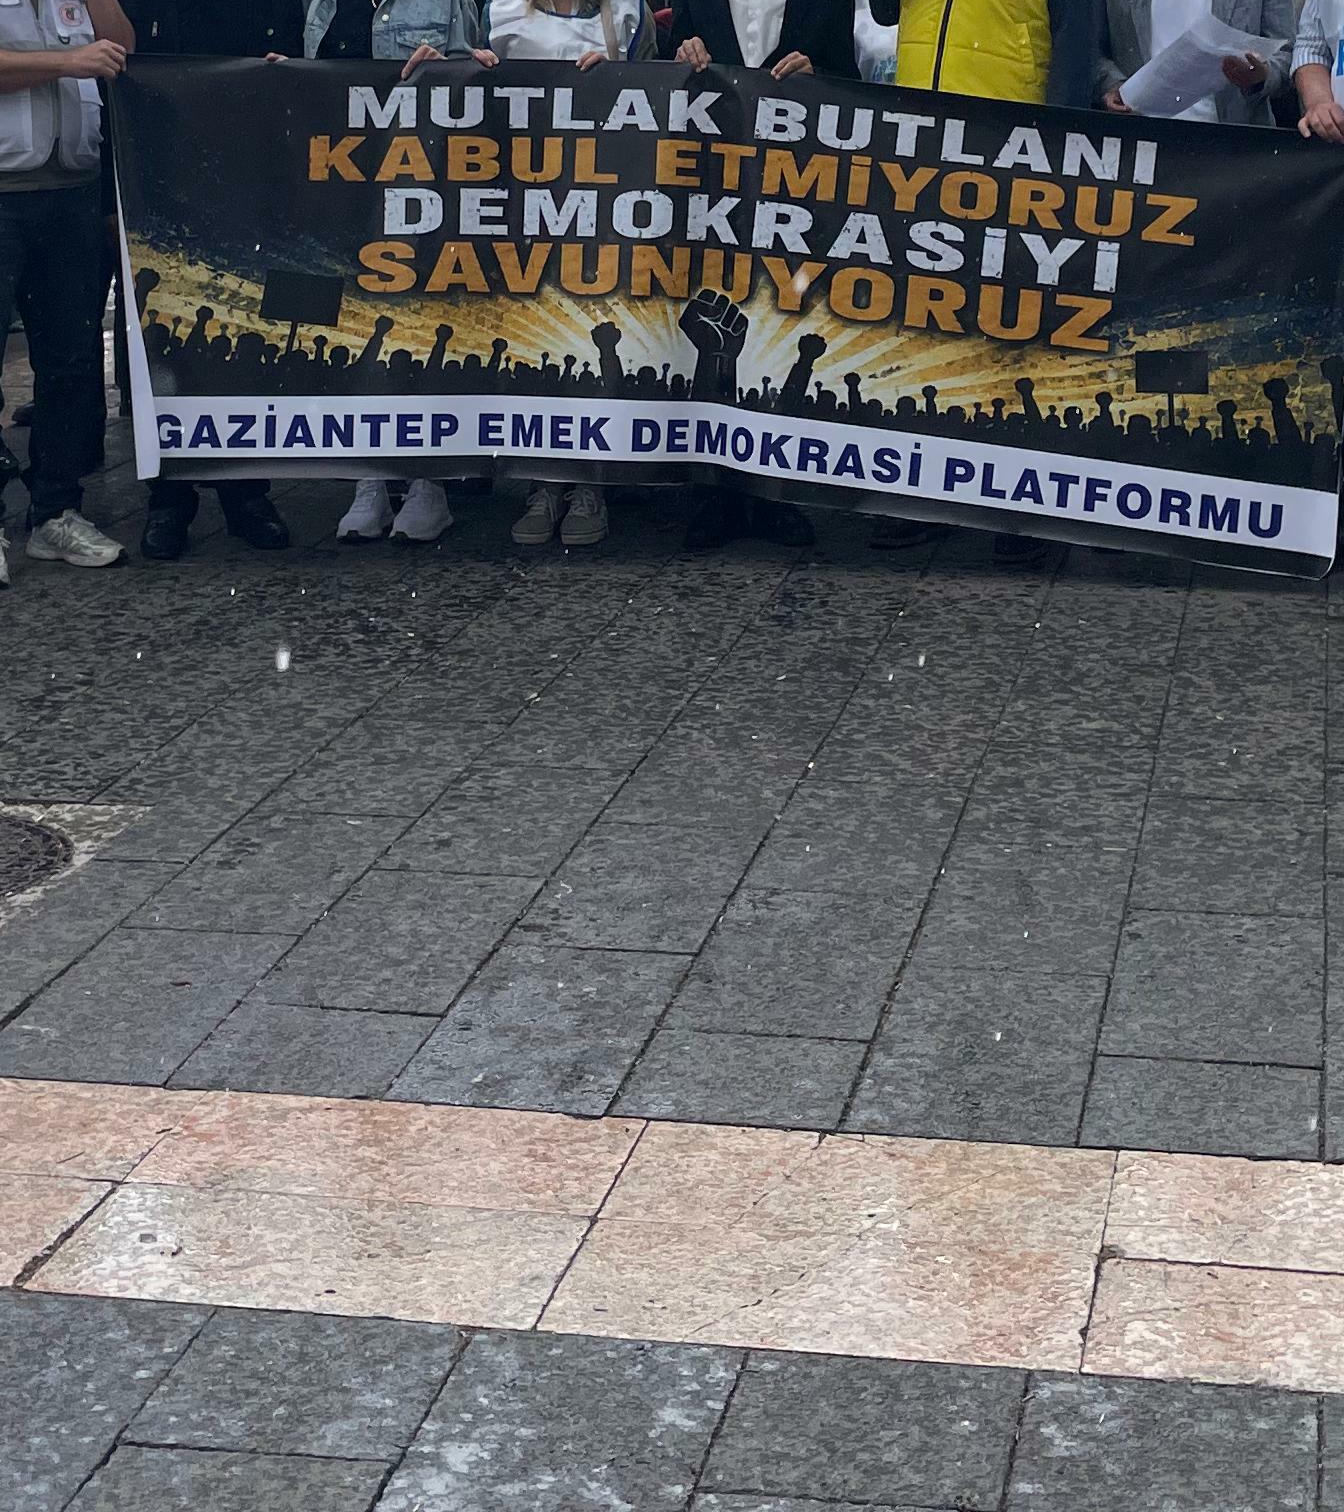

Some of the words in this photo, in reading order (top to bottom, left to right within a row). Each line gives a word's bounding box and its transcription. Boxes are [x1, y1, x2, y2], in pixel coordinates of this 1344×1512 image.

[308, 134, 619, 185] KABUL
[655, 138, 1199, 247] ETMİYORUZ
[347, 85, 722, 135] MUTLAK
[755, 96, 1158, 186] BUTLANI
[357, 239, 1113, 352] SAVUNUYORUZ
[383, 187, 1122, 294] DEMOKRASİYİ
[156, 403, 460, 450] GAZİANTEP
[477, 413, 612, 451] EMEK
[632, 418, 922, 489] DEMOKRASİ
[943, 457, 1284, 540] PLATFORMU
